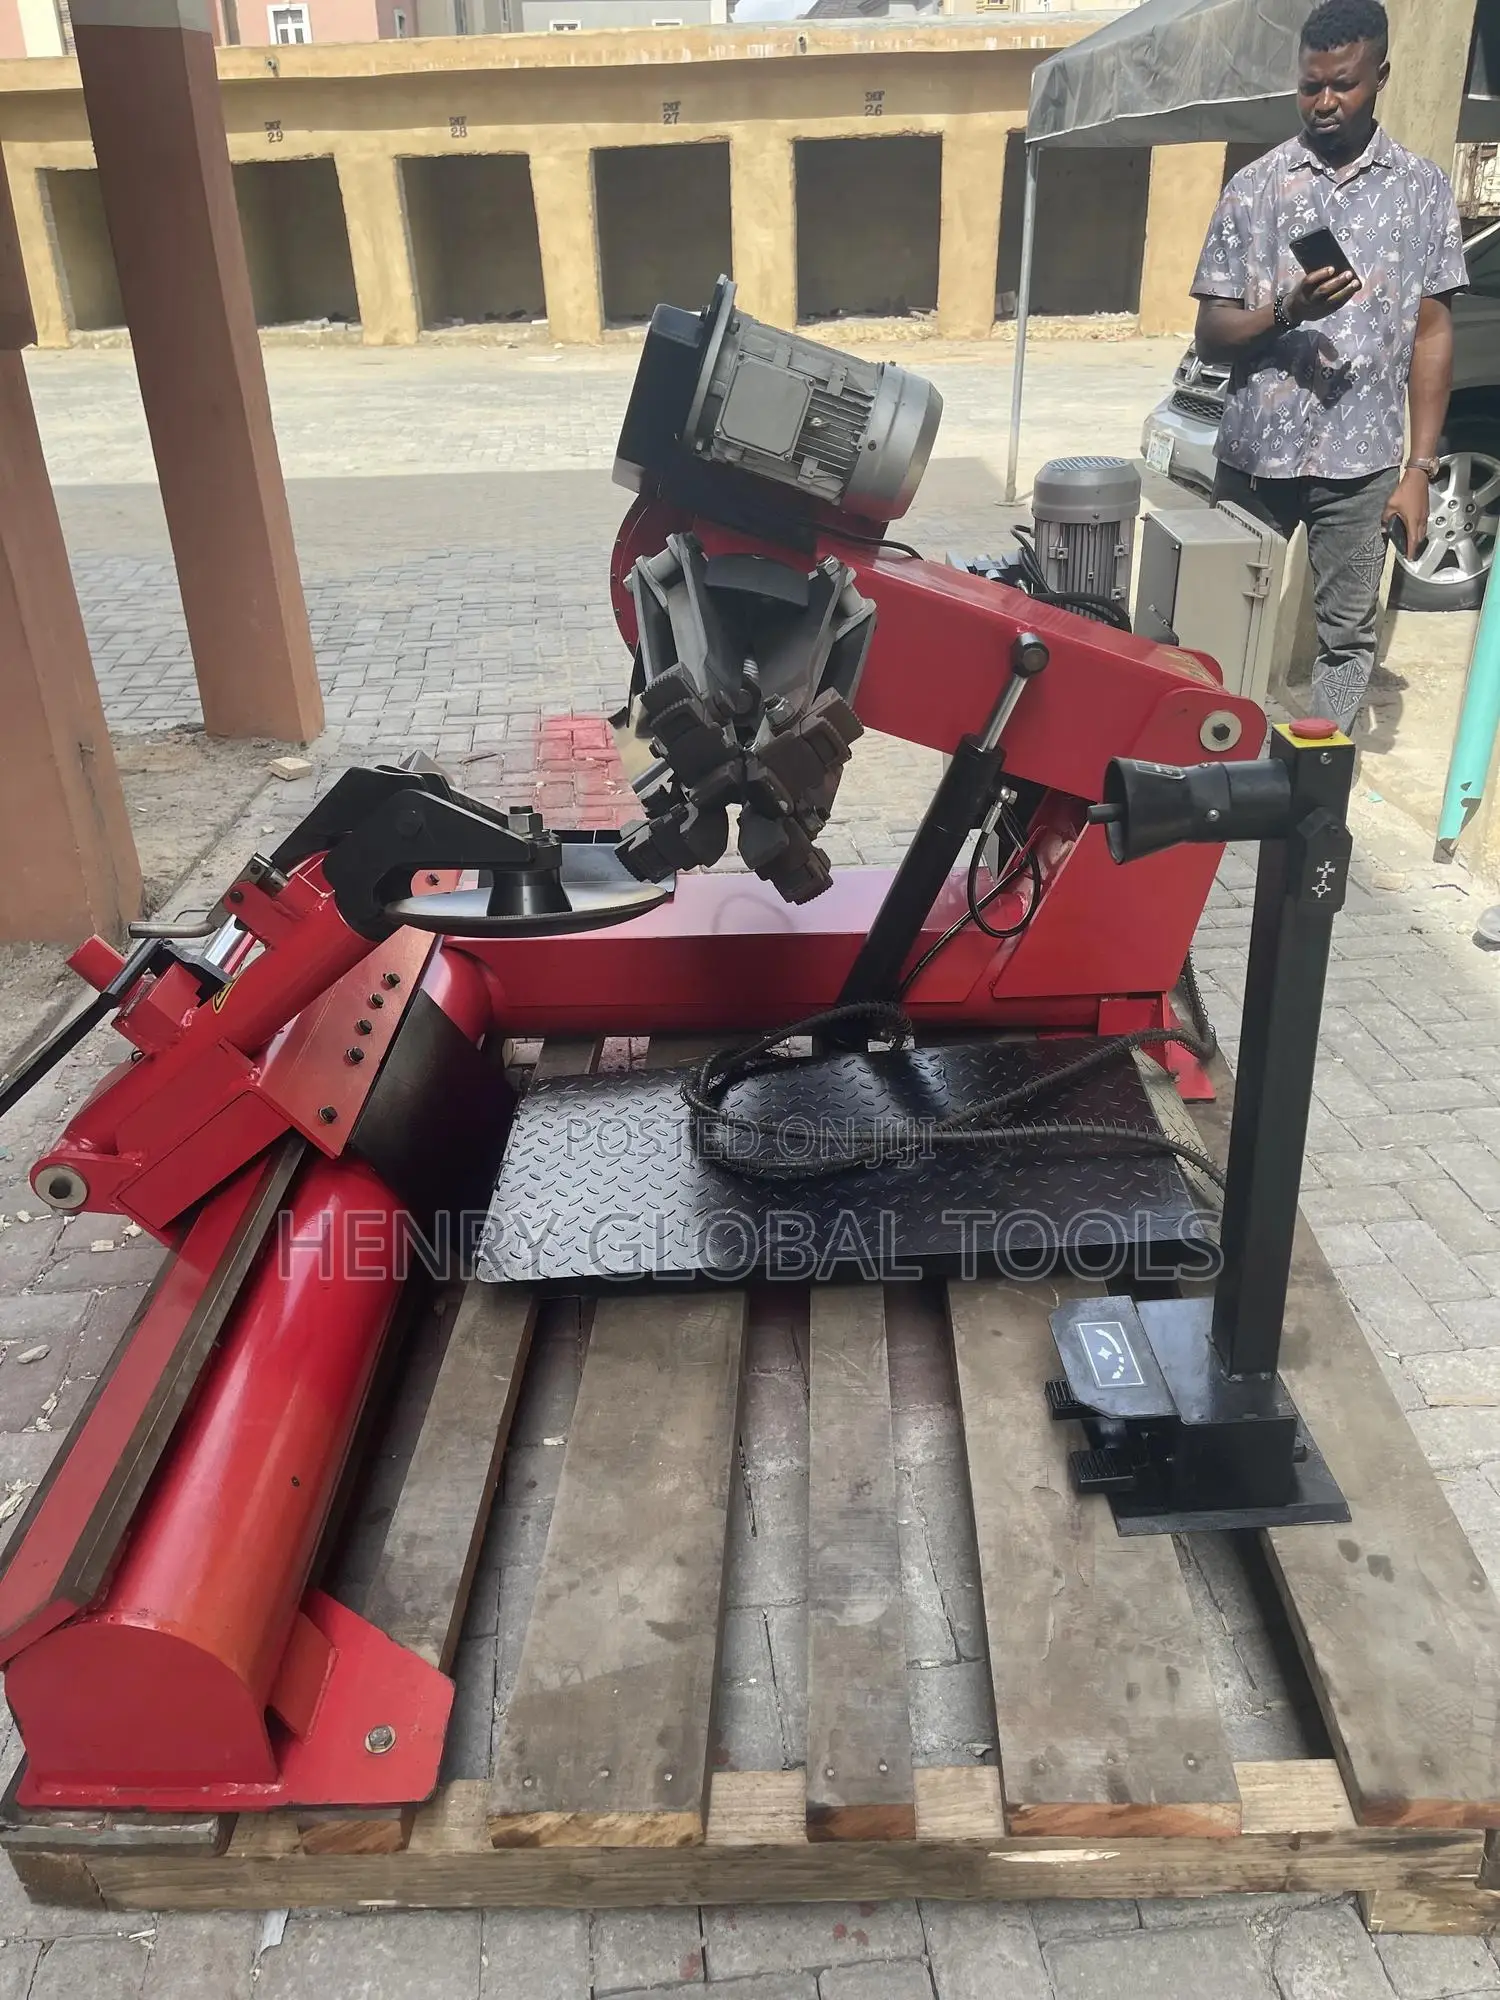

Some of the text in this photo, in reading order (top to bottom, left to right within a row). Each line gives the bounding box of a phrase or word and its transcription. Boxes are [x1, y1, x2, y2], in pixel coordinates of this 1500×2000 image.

[864, 104, 882, 117] 26
[663, 111, 680, 125] 27
[267, 131, 283, 143] 29
[450, 126, 467, 138] 28
